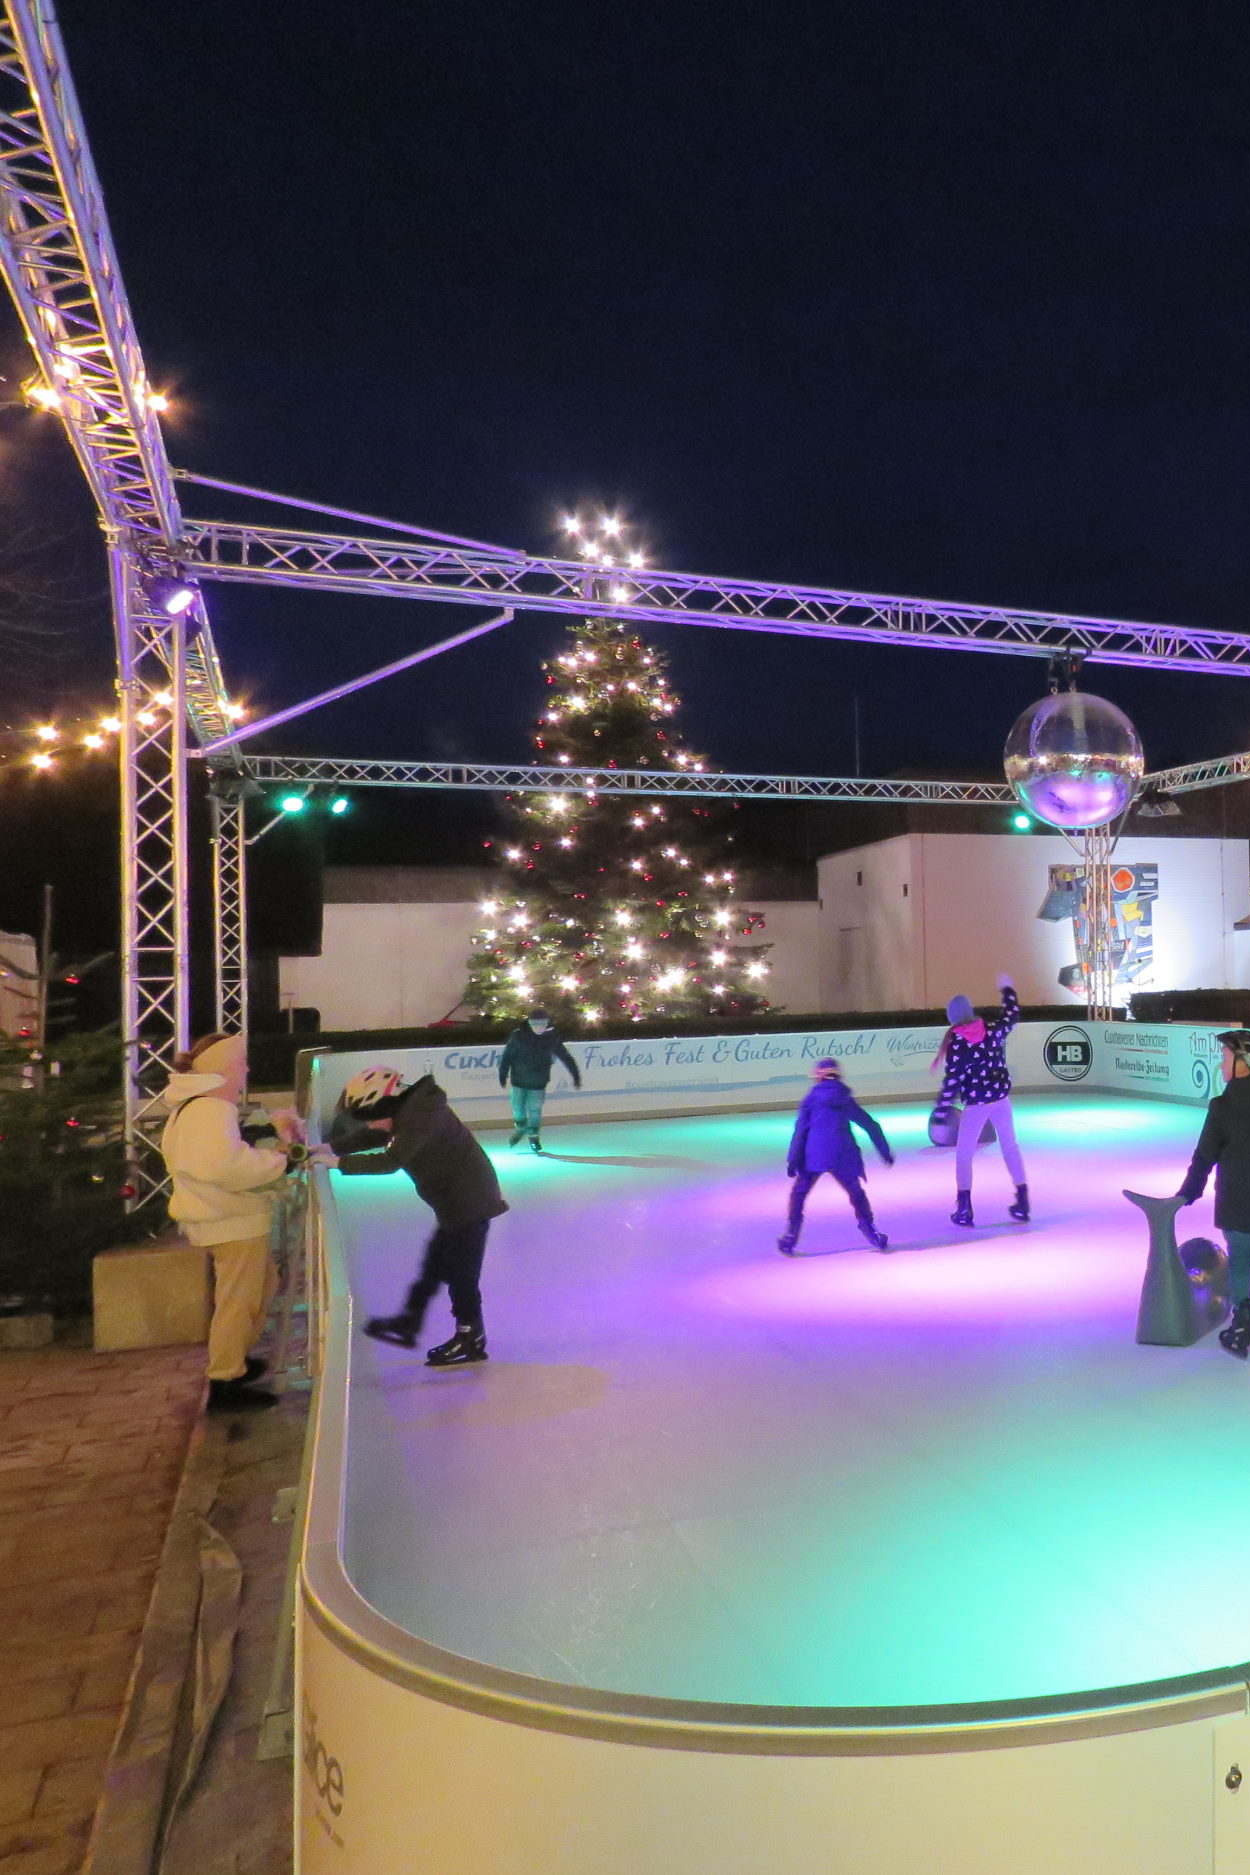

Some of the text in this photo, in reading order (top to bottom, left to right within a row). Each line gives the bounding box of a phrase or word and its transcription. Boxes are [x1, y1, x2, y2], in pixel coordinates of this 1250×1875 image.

[1136, 1032, 1169, 1049] Nachrichten
[444, 1049, 502, 1070] Cuxh
[584, 1033, 878, 1069] Frohes Fest & Guten Rutsch!
[1057, 1045, 1083, 1063] HB
